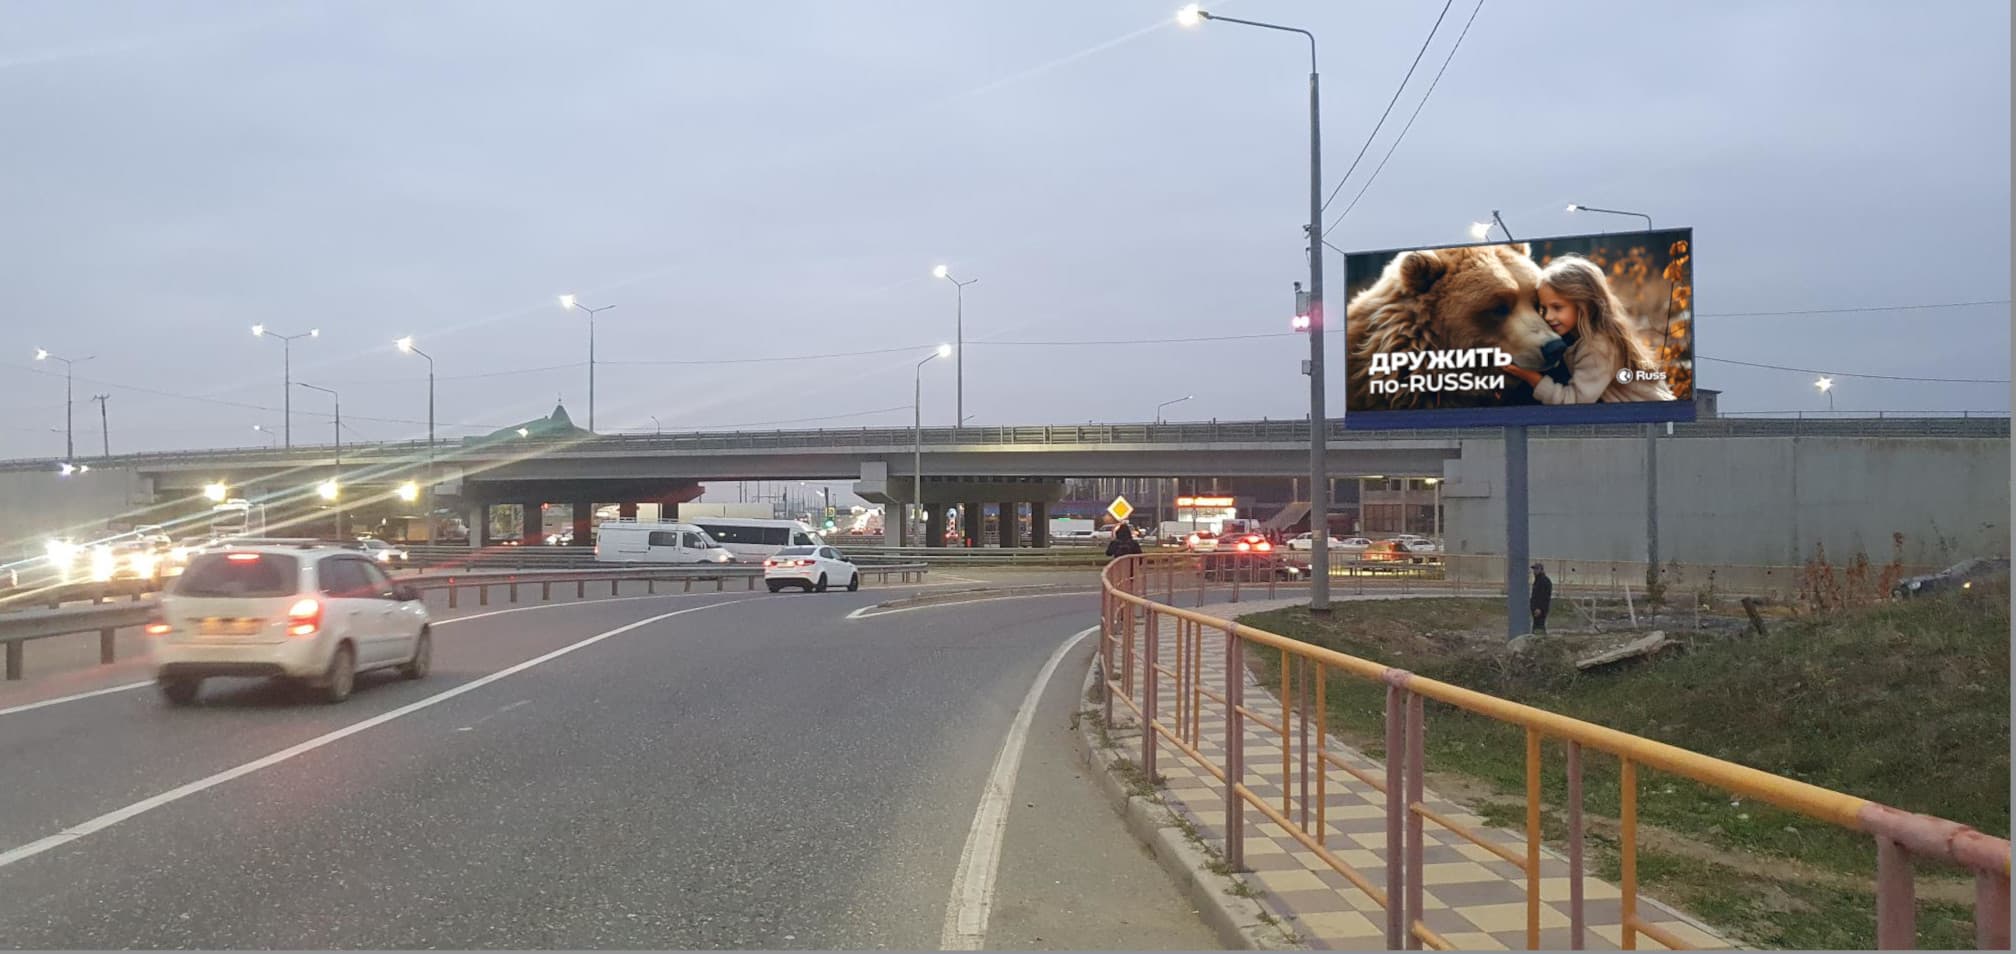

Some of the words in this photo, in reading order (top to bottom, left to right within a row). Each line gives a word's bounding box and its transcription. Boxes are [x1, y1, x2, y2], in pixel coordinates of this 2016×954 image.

[1370, 348, 1512, 375] ДРУЖИТЬ
[1370, 372, 1505, 394] по-RUSSки
[1636, 370, 1667, 381] Russ
